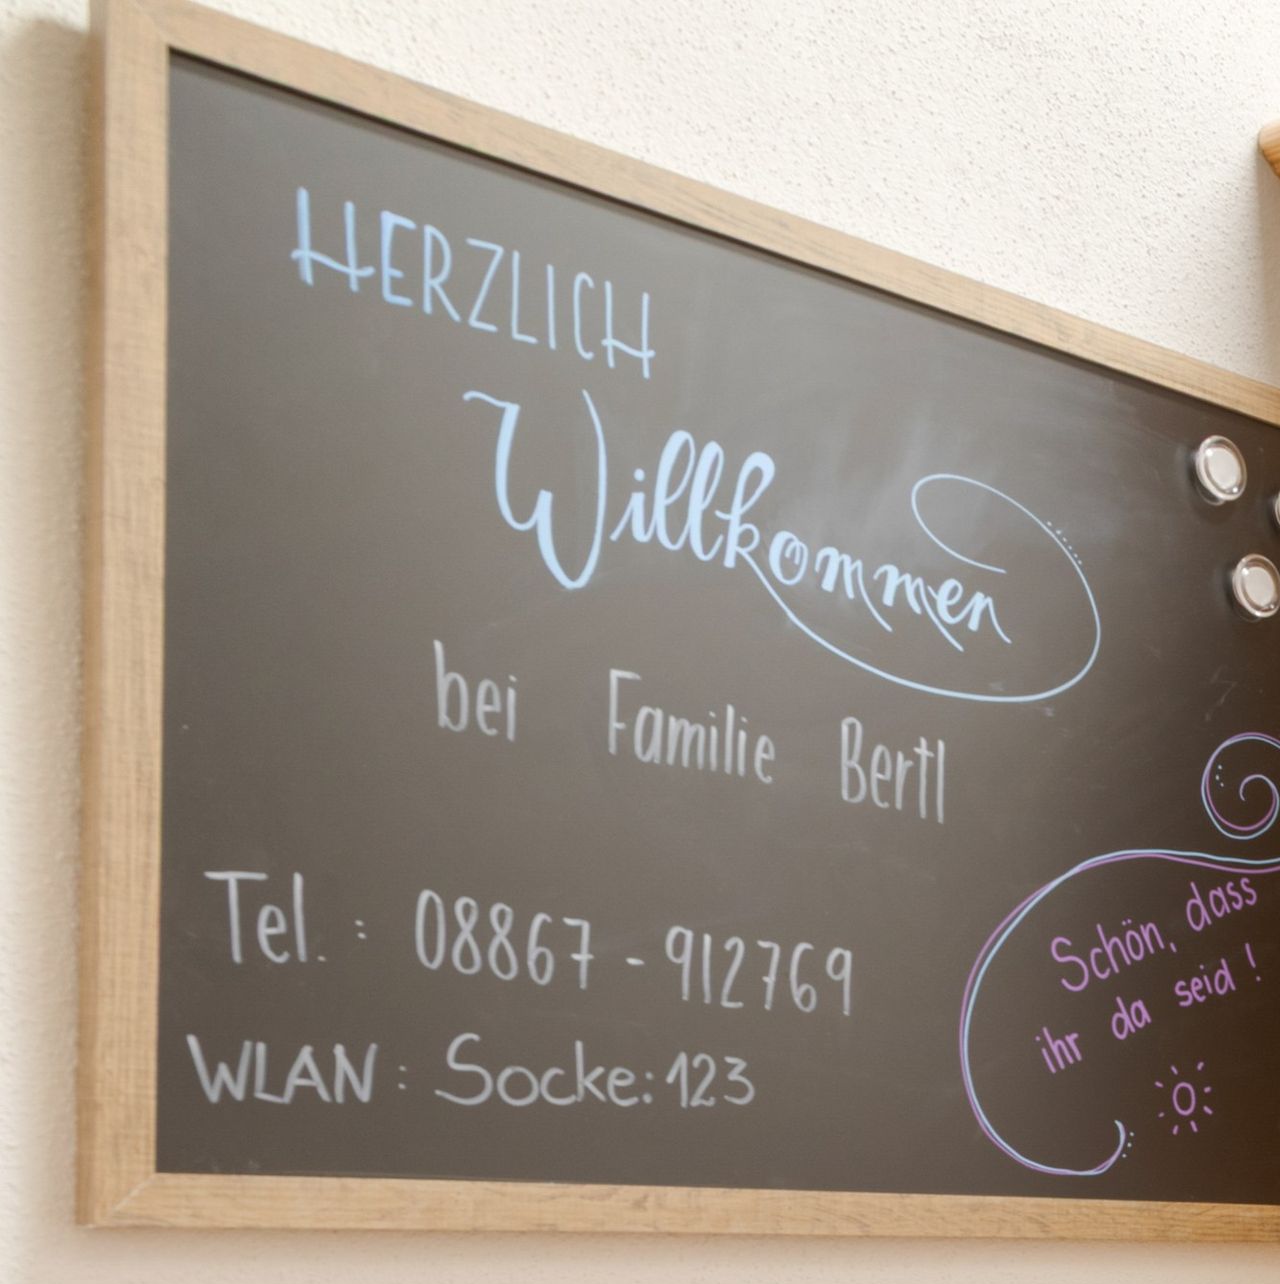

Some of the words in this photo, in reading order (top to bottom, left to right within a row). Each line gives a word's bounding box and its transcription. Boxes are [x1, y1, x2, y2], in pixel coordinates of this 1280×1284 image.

[292, 187, 656, 379] HERZLICH
[462, 389, 1012, 652] Willkommen
[434, 639, 518, 742] bei
[608, 668, 776, 784] Familie
[840, 716, 945, 824] Bertl
[414, 889, 596, 989] 08867
[665, 925, 854, 1016] 912769
[1050, 918, 1178, 992] Schön,
[1186, 877, 1257, 931] dass
[1035, 1026, 1082, 1074] ihr
[1111, 996, 1151, 1040] da
[1174, 958, 1235, 1007] seid
